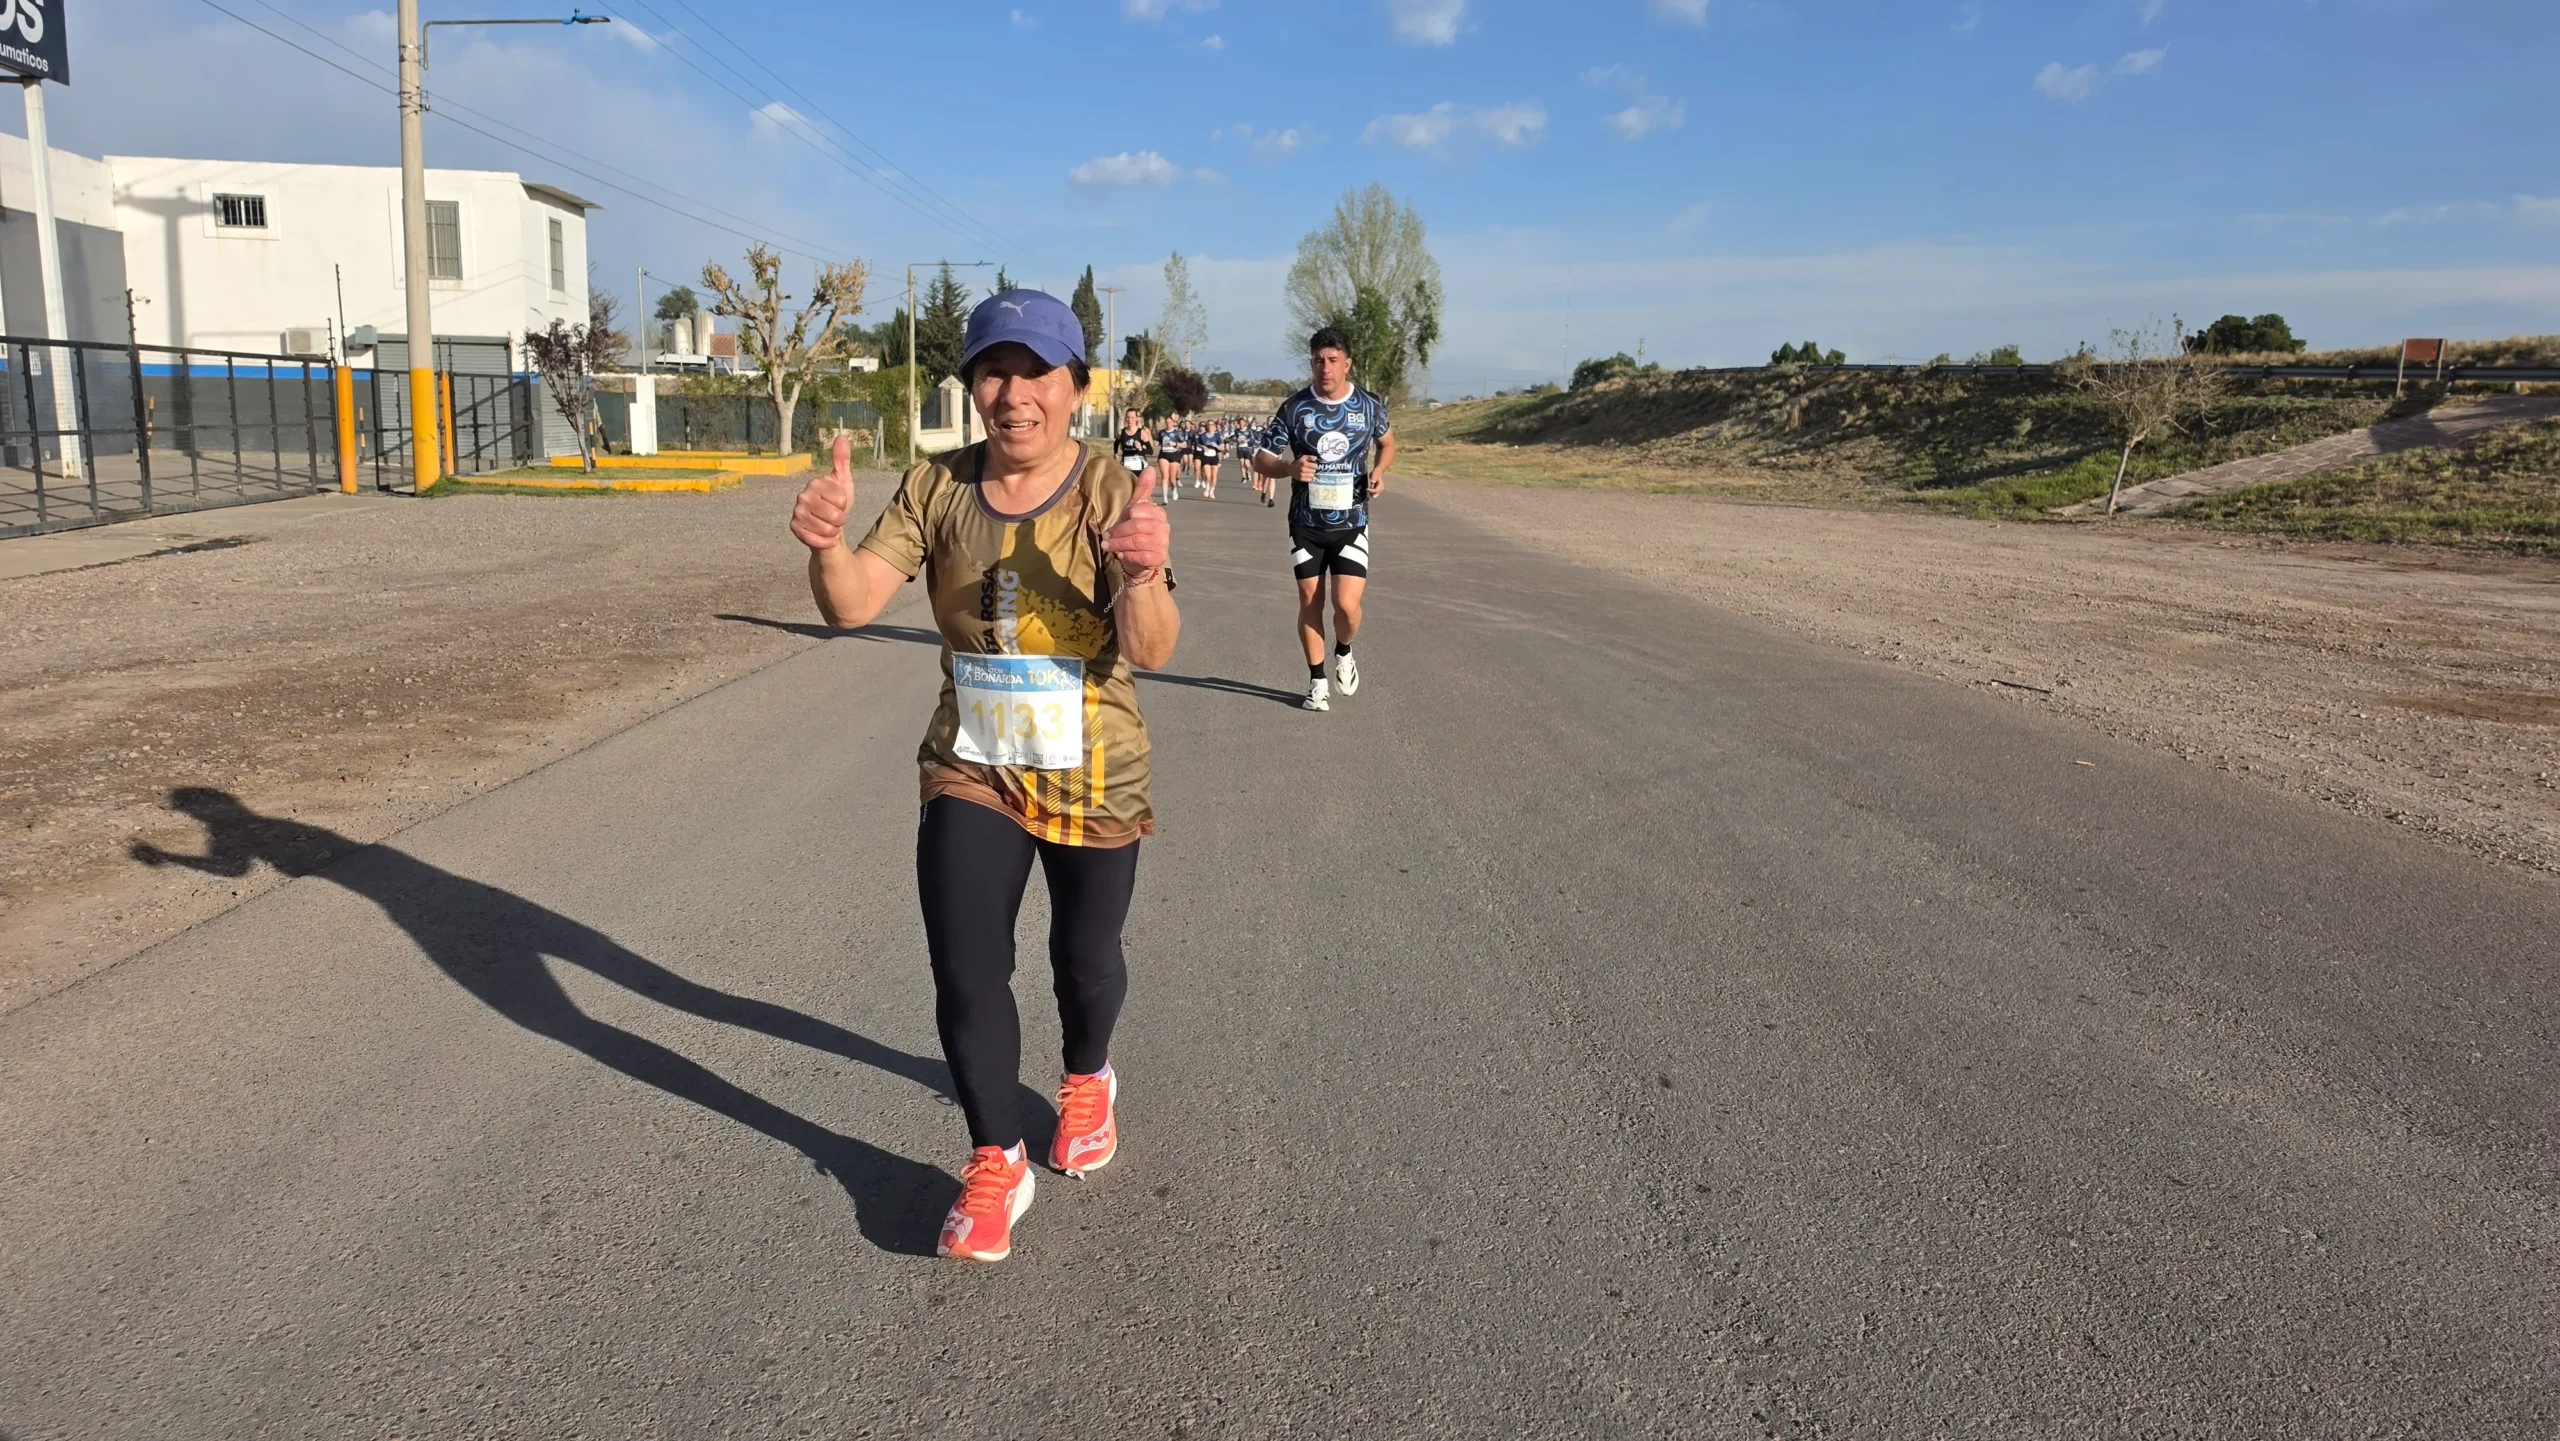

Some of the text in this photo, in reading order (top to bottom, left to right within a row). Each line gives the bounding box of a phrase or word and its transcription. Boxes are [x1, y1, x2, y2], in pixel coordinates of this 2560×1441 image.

[981, 567, 995, 622] ROSA
[974, 671, 1024, 685] BONARDA
[971, 699, 1064, 741] 1133
